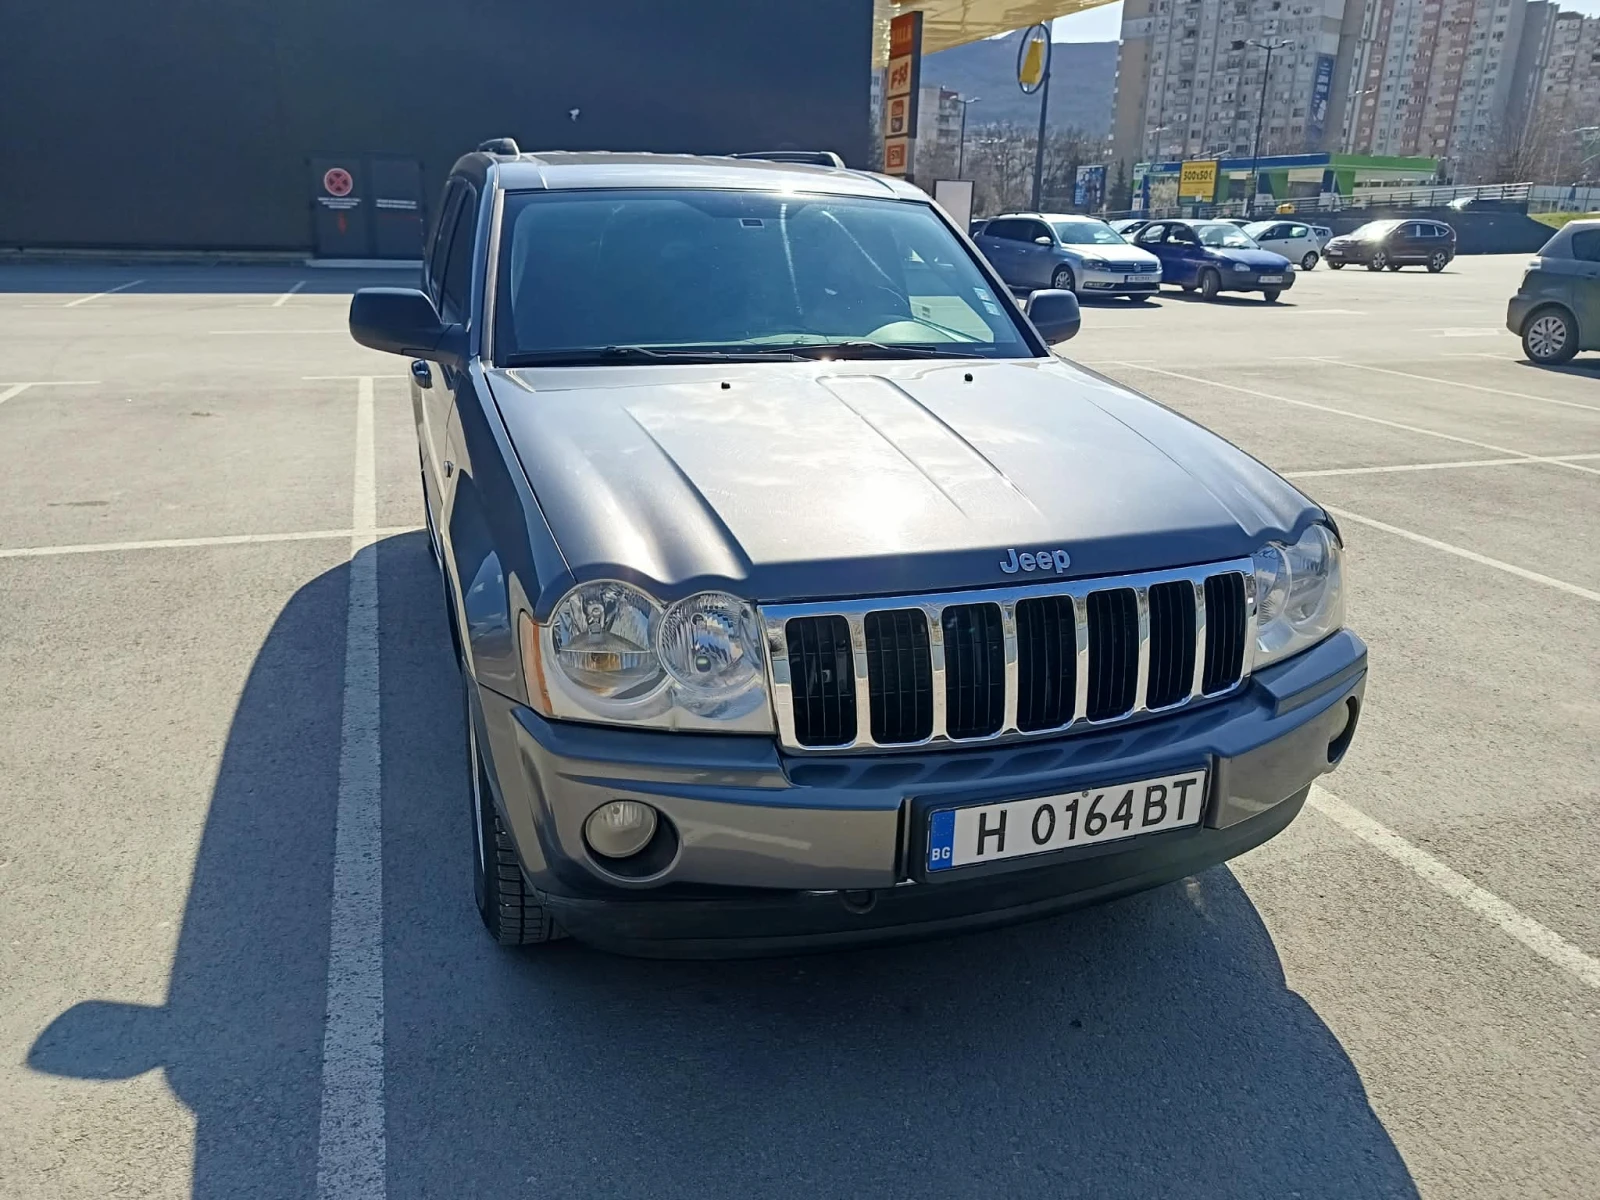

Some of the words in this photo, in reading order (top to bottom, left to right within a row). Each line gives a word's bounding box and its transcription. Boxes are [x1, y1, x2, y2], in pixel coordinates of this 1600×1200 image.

[999, 548, 1071, 574] Jeep
[976, 809, 1008, 856] H
[1031, 778, 1197, 846] 0164BT
[931, 846, 951, 861] BG
